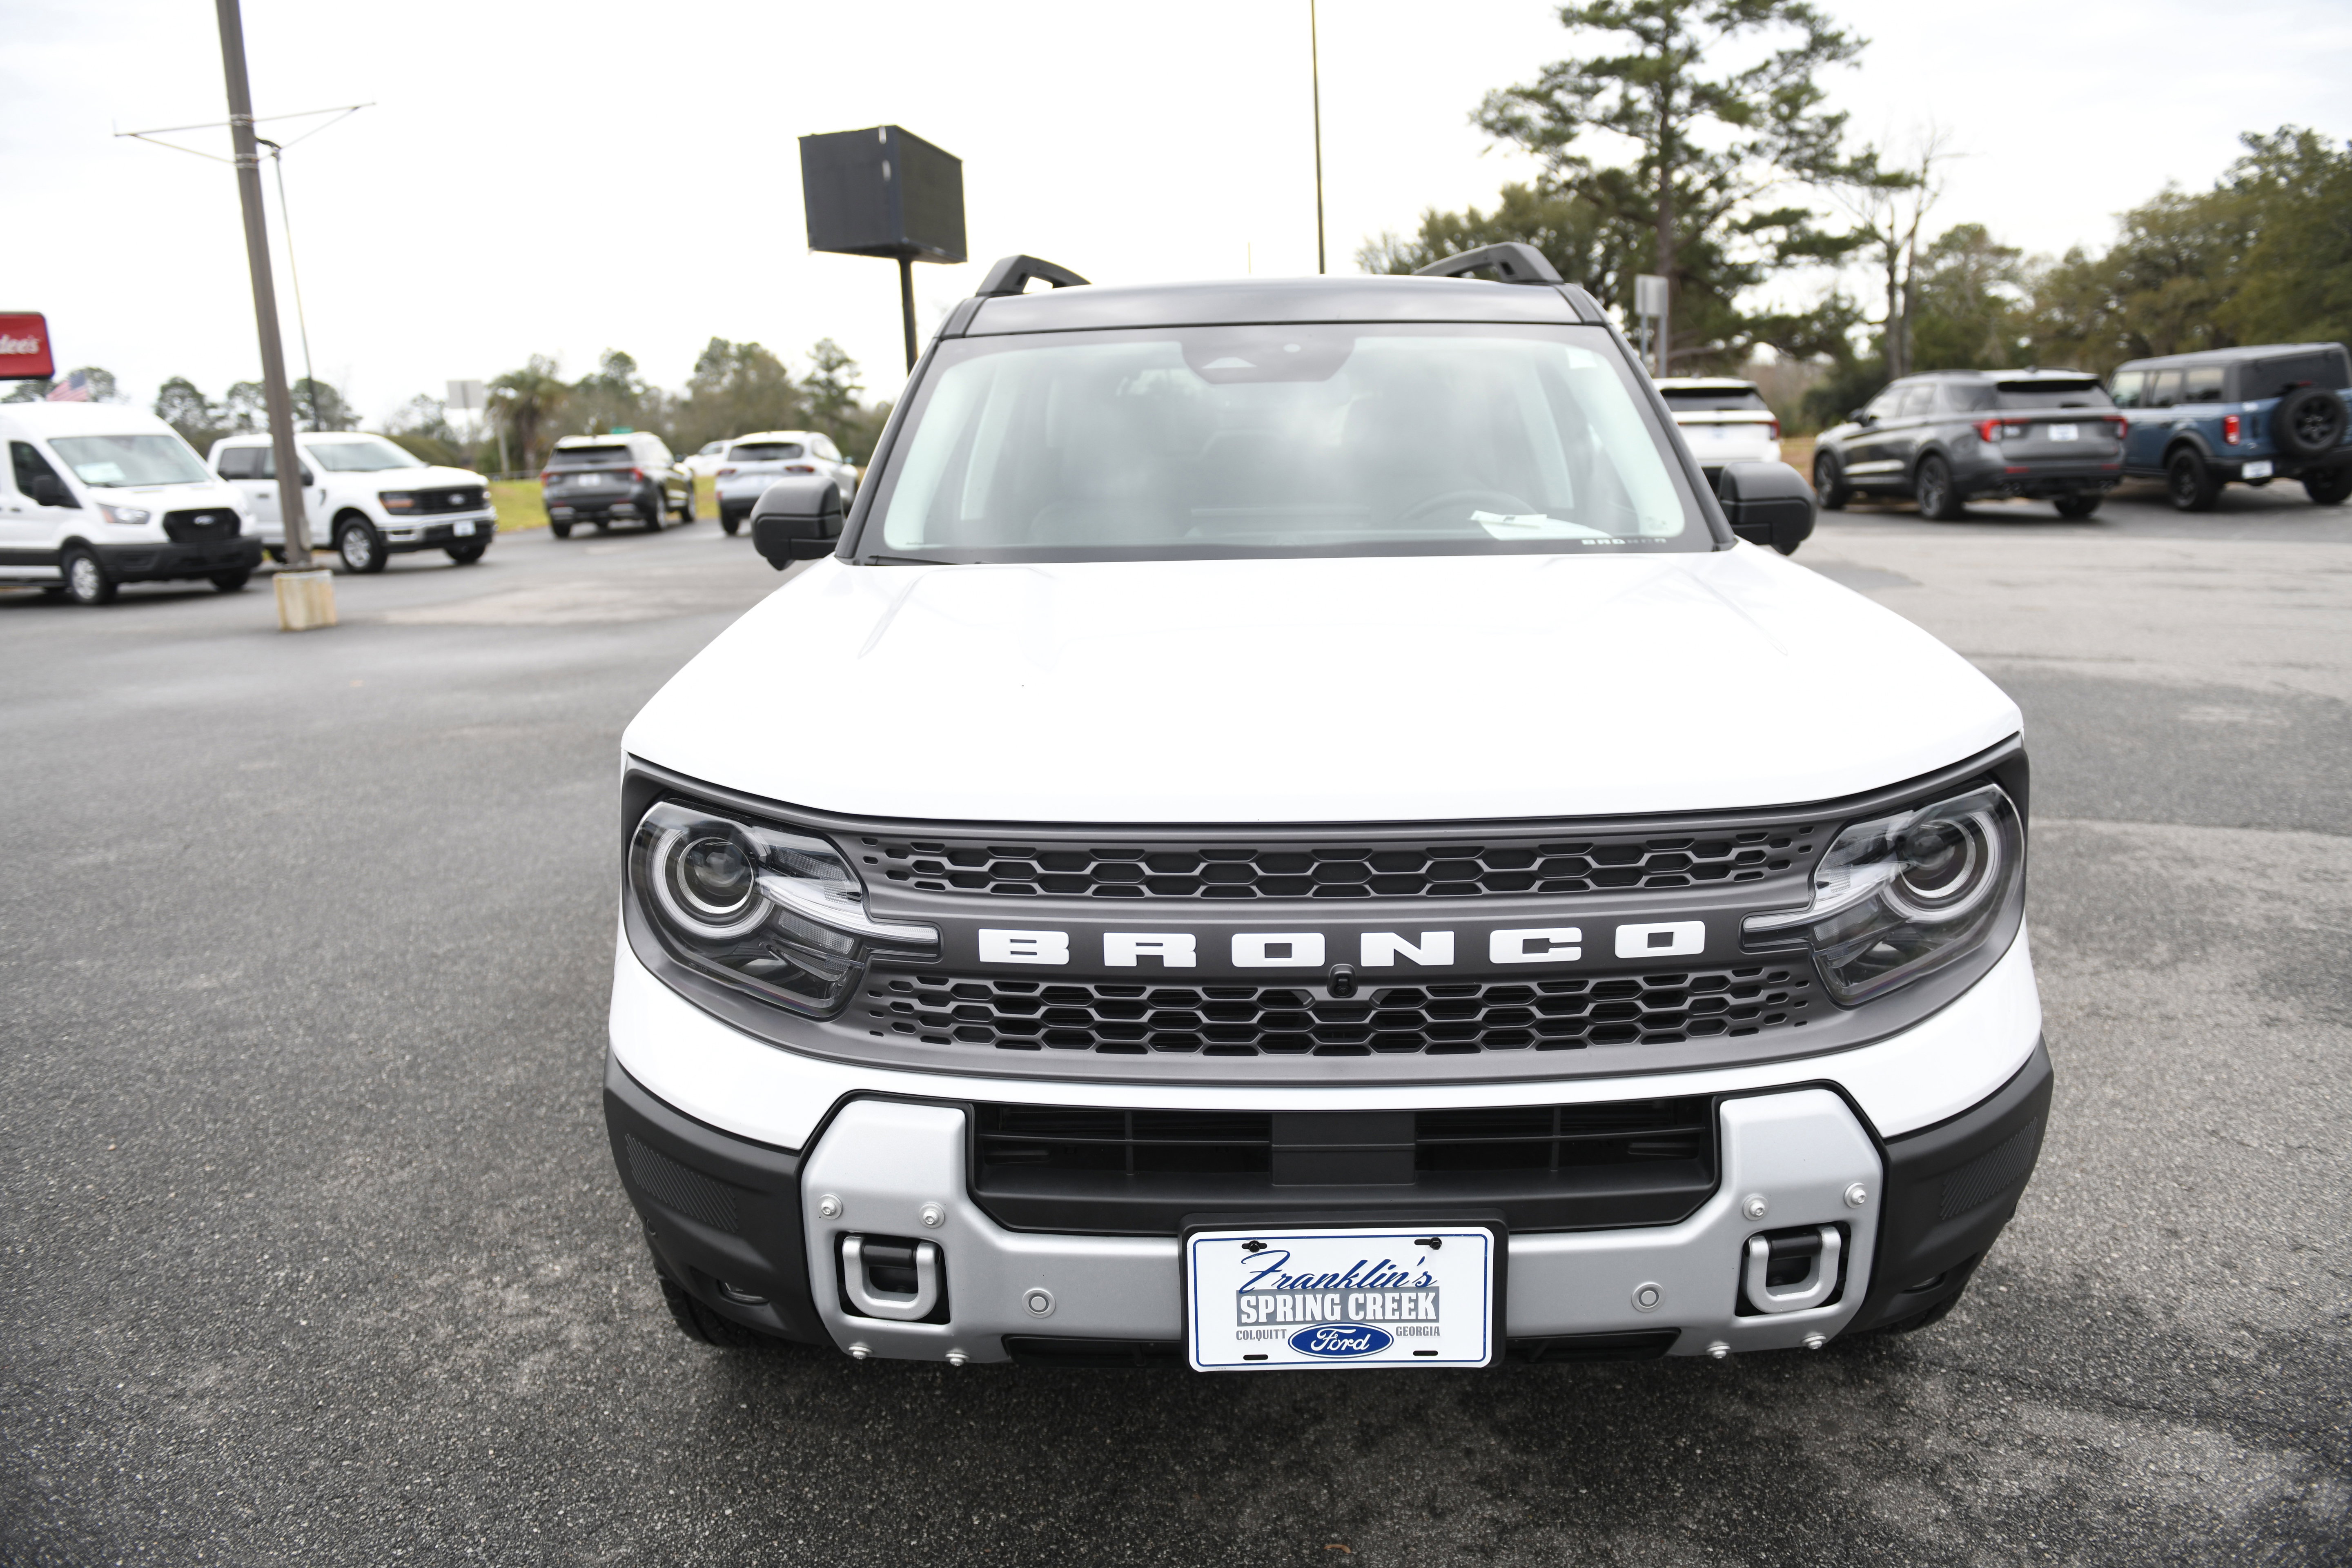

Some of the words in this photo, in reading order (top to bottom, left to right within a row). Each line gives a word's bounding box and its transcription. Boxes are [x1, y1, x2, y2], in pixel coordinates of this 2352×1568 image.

[978, 920, 1706, 967] BRONCO
[1238, 1250, 1438, 1294] Franklin's
[1240, 1293, 1341, 1323] SPRING
[1348, 1292, 1437, 1320] CREEK
[1236, 1329, 1287, 1342] COLQUITT
[1311, 1327, 1371, 1351] Ford
[1395, 1326, 1441, 1337] GEORGIA
